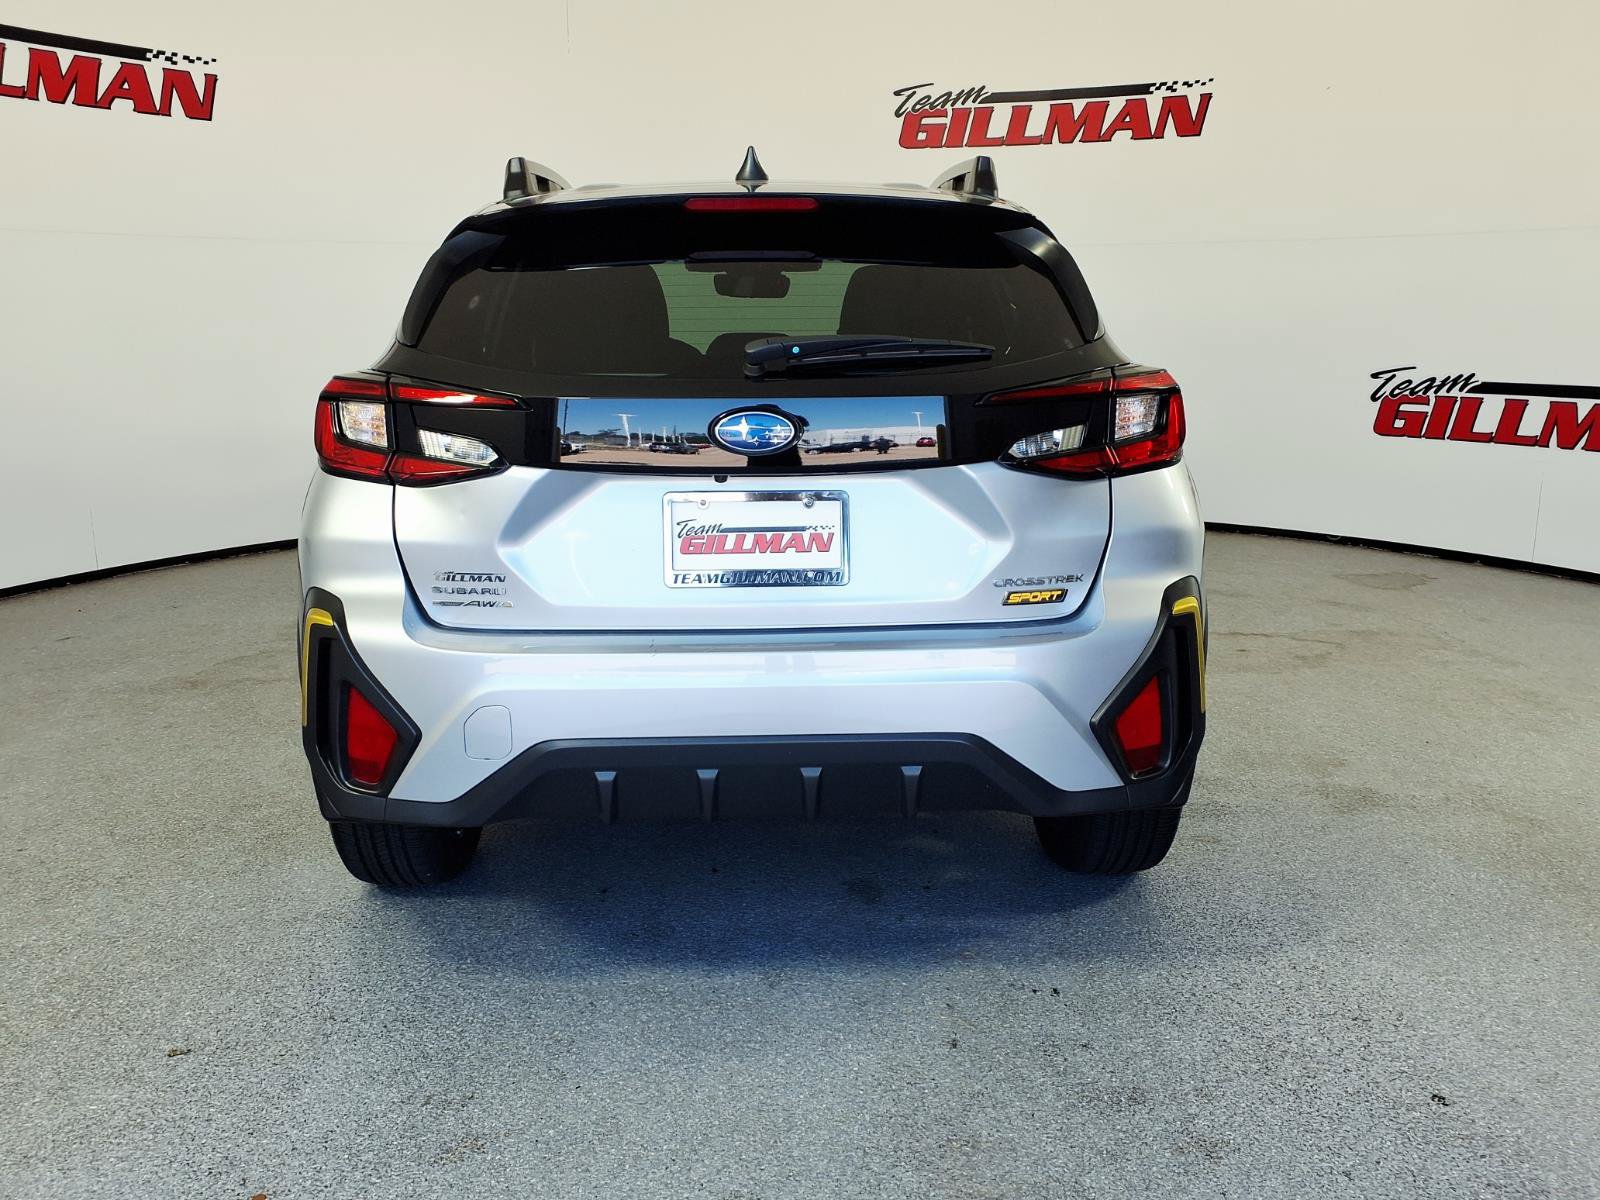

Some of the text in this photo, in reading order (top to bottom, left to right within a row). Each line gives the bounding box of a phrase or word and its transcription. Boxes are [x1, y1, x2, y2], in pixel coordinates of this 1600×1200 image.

[893, 83, 991, 118] Team
[898, 93, 1213, 149] GILLMAN
[1370, 366, 1479, 402] Team
[676, 518, 723, 539] Team
[679, 532, 835, 555] GILLMAN
[435, 573, 506, 583] GILLMAN
[672, 570, 843, 585] TEAMGILLMAN.COM
[993, 573, 1085, 588] CROSSTREK
[431, 586, 507, 596] SUBARU
[1007, 590, 1062, 604] SPORT
